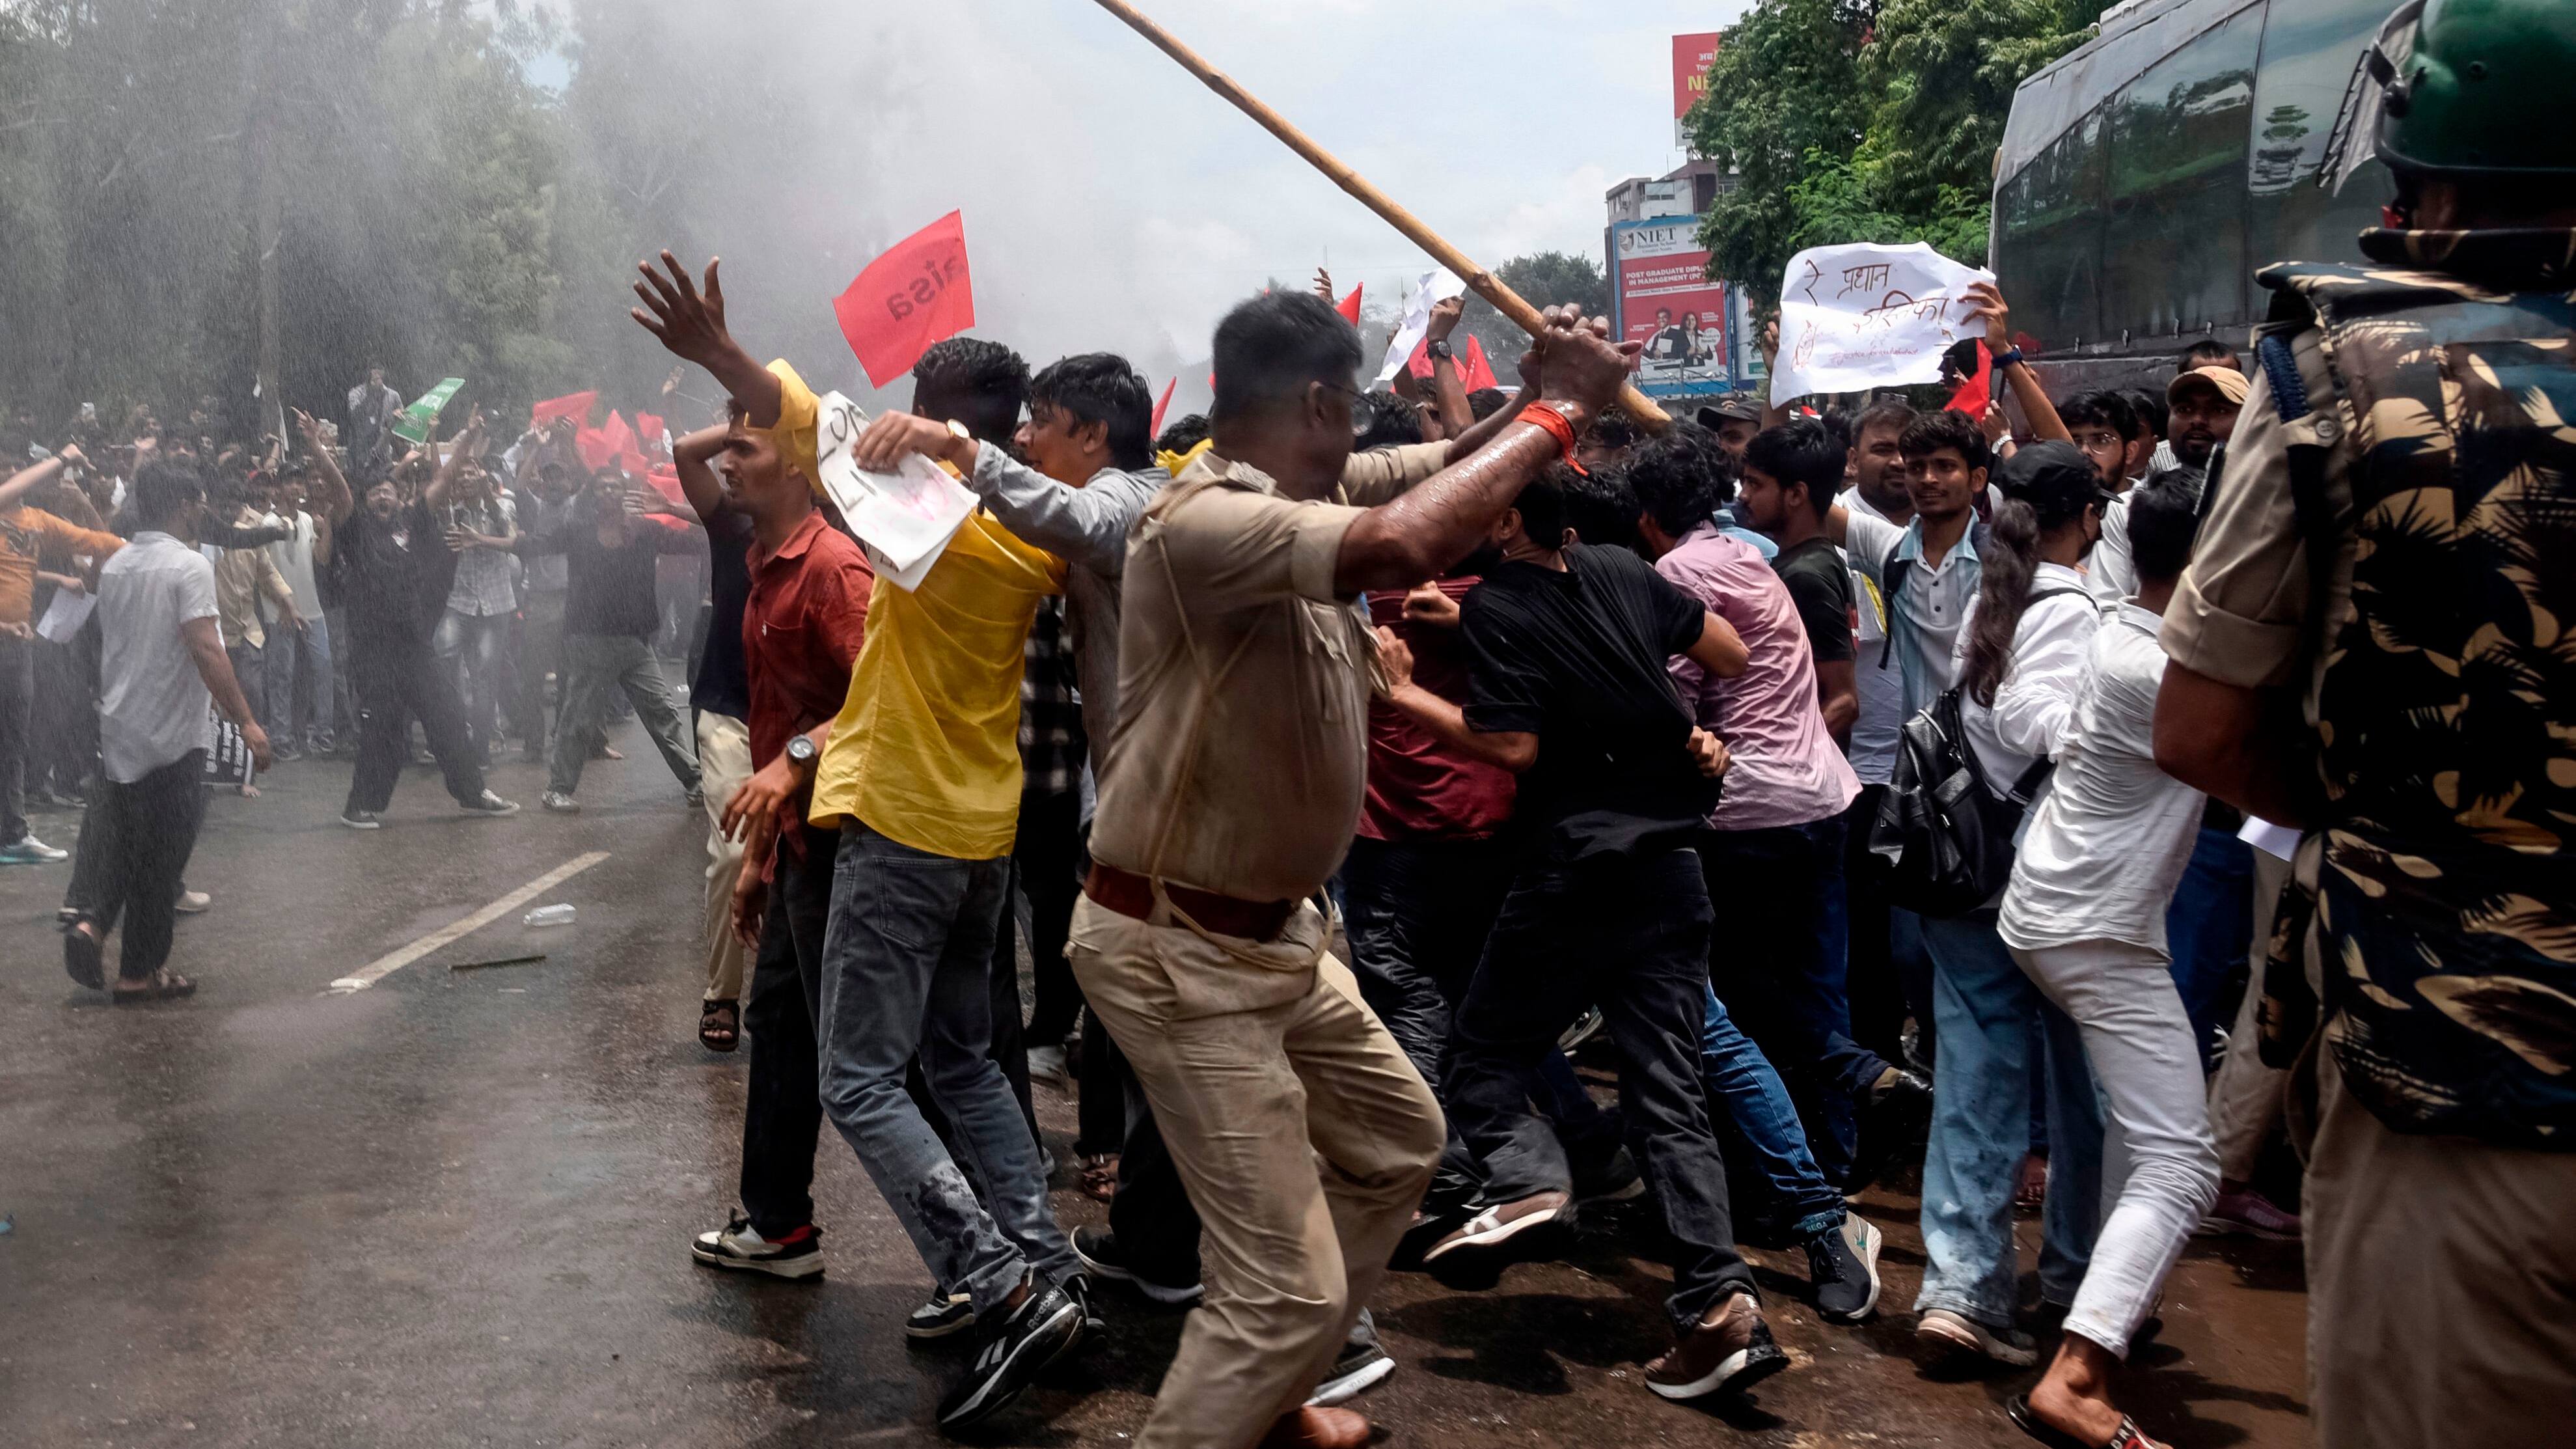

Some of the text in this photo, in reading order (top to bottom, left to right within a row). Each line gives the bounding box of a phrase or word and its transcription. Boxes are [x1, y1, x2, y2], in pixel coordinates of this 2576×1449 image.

[1637, 227, 1677, 243] NIET
[1646, 267, 1684, 277] GRADUATE
[1637, 275, 1687, 285] MANAGEMENT
[1027, 1289, 1061, 1329] Reebok
